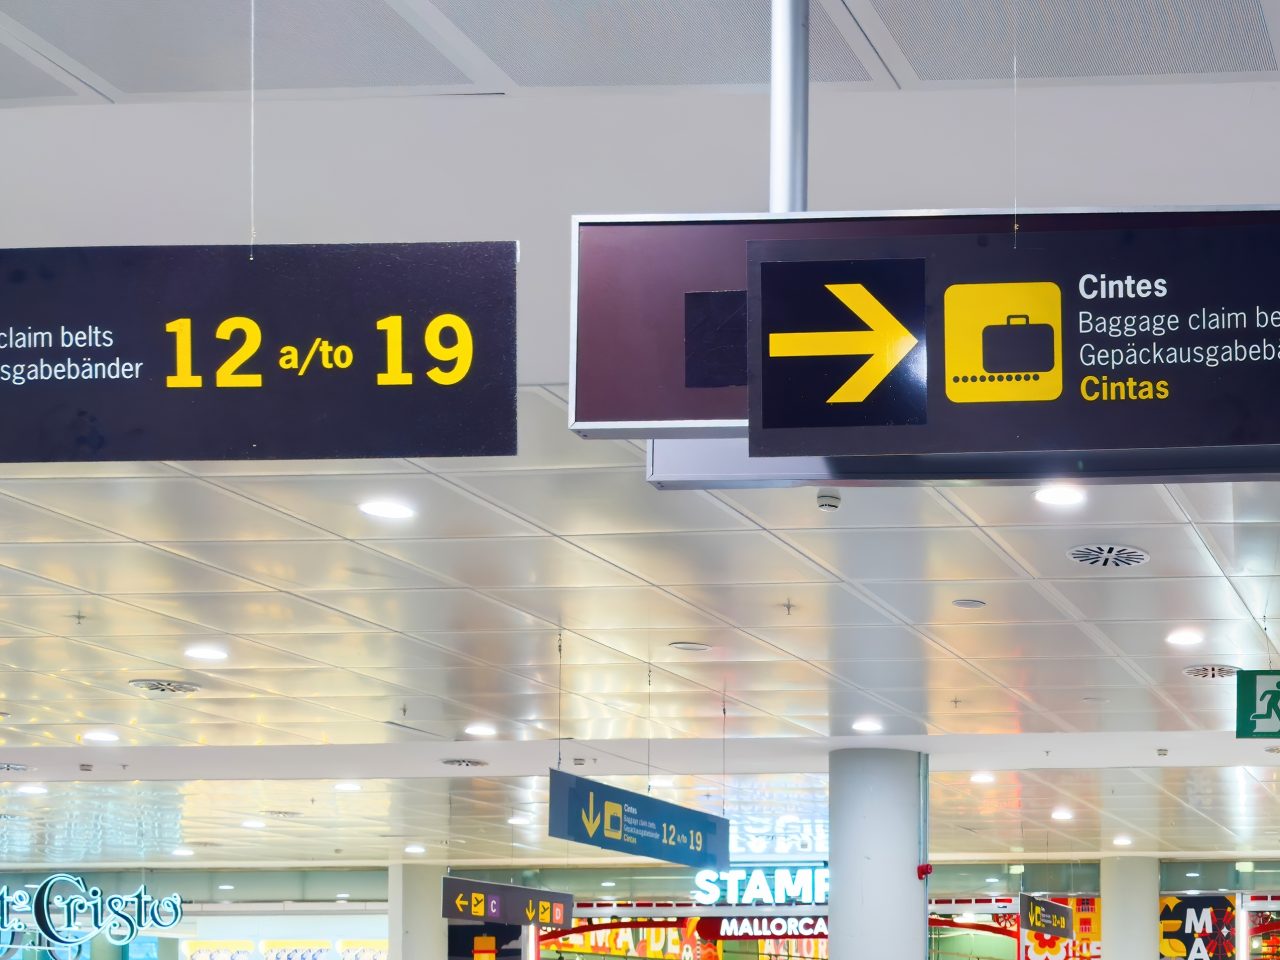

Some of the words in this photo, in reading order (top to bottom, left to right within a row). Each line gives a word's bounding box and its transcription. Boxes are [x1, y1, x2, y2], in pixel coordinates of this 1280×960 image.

[1078, 273, 1168, 299] Cintes
[1078, 310, 1180, 338] Baggage
[1189, 306, 1248, 331] claim
[60, 325, 114, 347] belts
[165, 316, 262, 388] 12
[278, 337, 354, 376] a/to
[376, 313, 474, 386] 19
[0, 357, 144, 385] sgabebänder
[1080, 375, 1170, 401] Cintas
[662, 822, 676, 846] 12
[689, 830, 703, 852] 19
[32, 873, 183, 946] Cristo
[490, 900, 498, 913] C
[720, 917, 829, 936] MALLORCA
